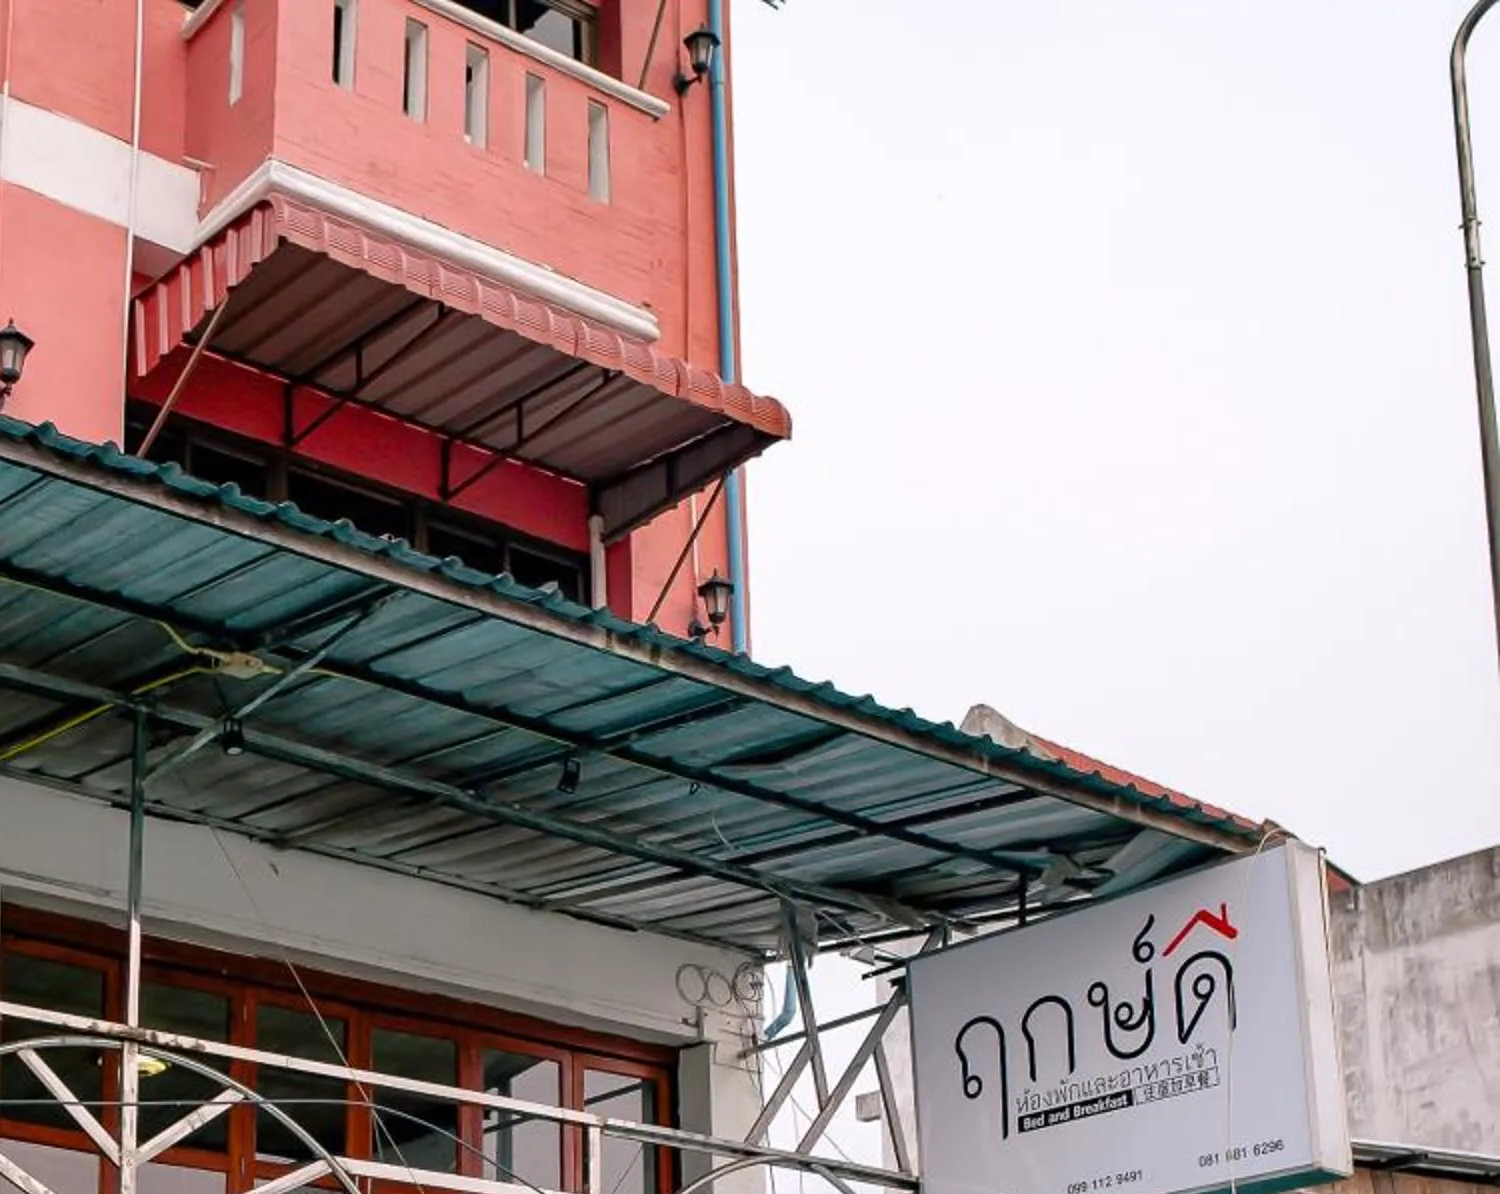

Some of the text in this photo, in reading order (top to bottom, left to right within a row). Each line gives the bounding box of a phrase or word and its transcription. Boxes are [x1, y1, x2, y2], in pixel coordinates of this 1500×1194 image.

[1023, 1093, 1129, 1130] Bed and Breakfast
[1199, 1153, 1219, 1167] 081
[1092, 1175, 1113, 1191] 112
